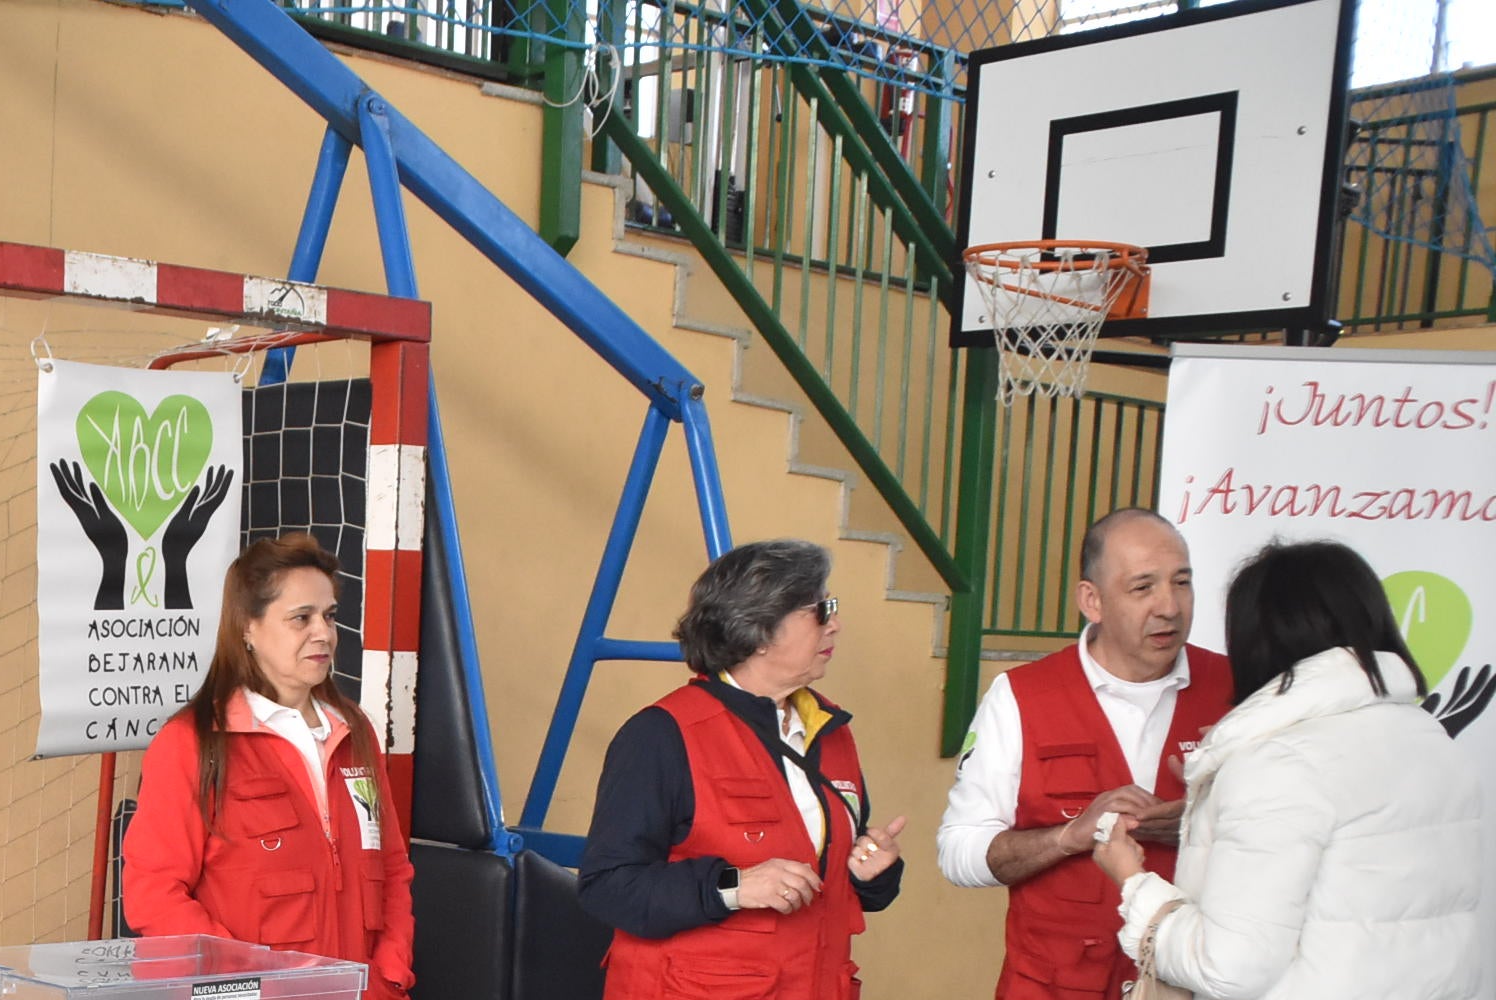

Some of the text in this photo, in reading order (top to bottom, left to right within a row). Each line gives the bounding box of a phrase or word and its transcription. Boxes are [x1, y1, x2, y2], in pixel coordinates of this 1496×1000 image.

[1257, 380, 1496, 435] ¡Juntos!
[86, 404, 192, 511] ABCC
[87, 615, 200, 641] ASOCIACIÓN
[88, 652, 198, 674] BEJARANA
[89, 685, 164, 707] CONTRA
[86, 717, 158, 741] CÁNC
[193, 980, 259, 995] NUEVA ASOCIACIÓN
